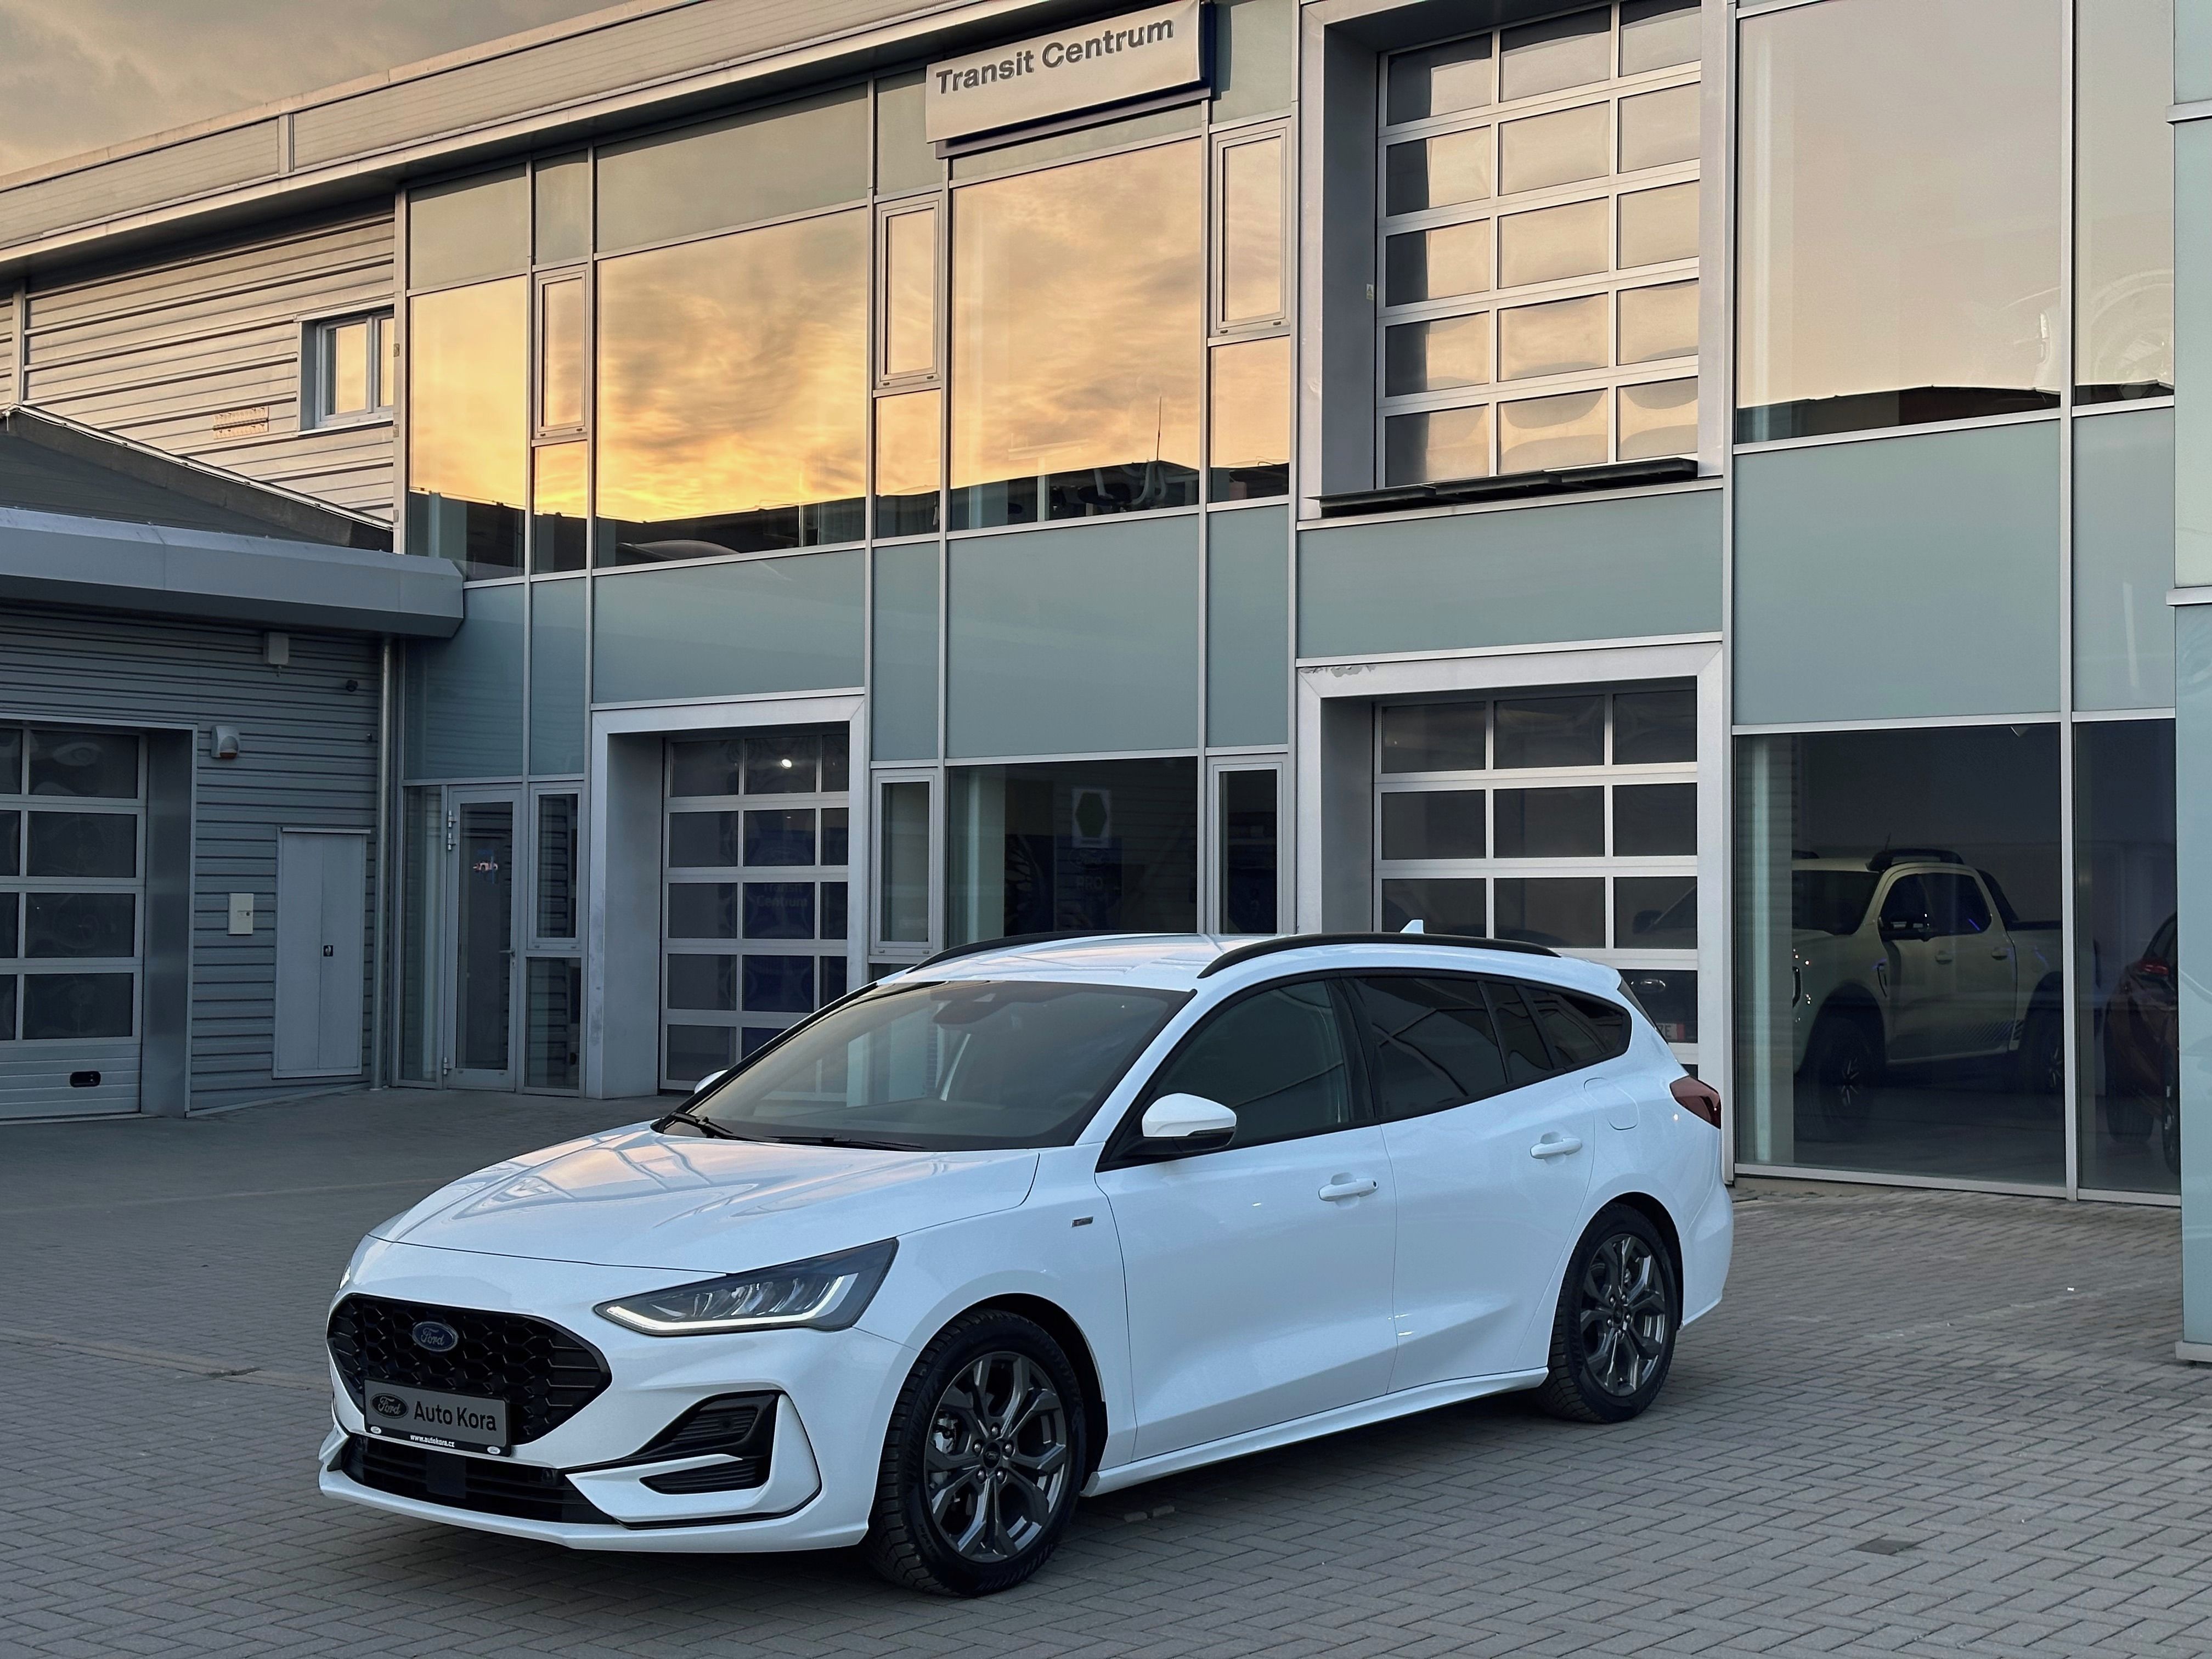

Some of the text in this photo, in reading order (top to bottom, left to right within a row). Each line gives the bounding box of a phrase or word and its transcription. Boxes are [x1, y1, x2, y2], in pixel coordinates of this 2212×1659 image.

[936, 19, 1173, 94] Transit Centrum
[414, 1401, 453, 1425] Auto
[457, 1407, 496, 1431] Kora
[410, 1435, 455, 1447] www.autokora.cz
